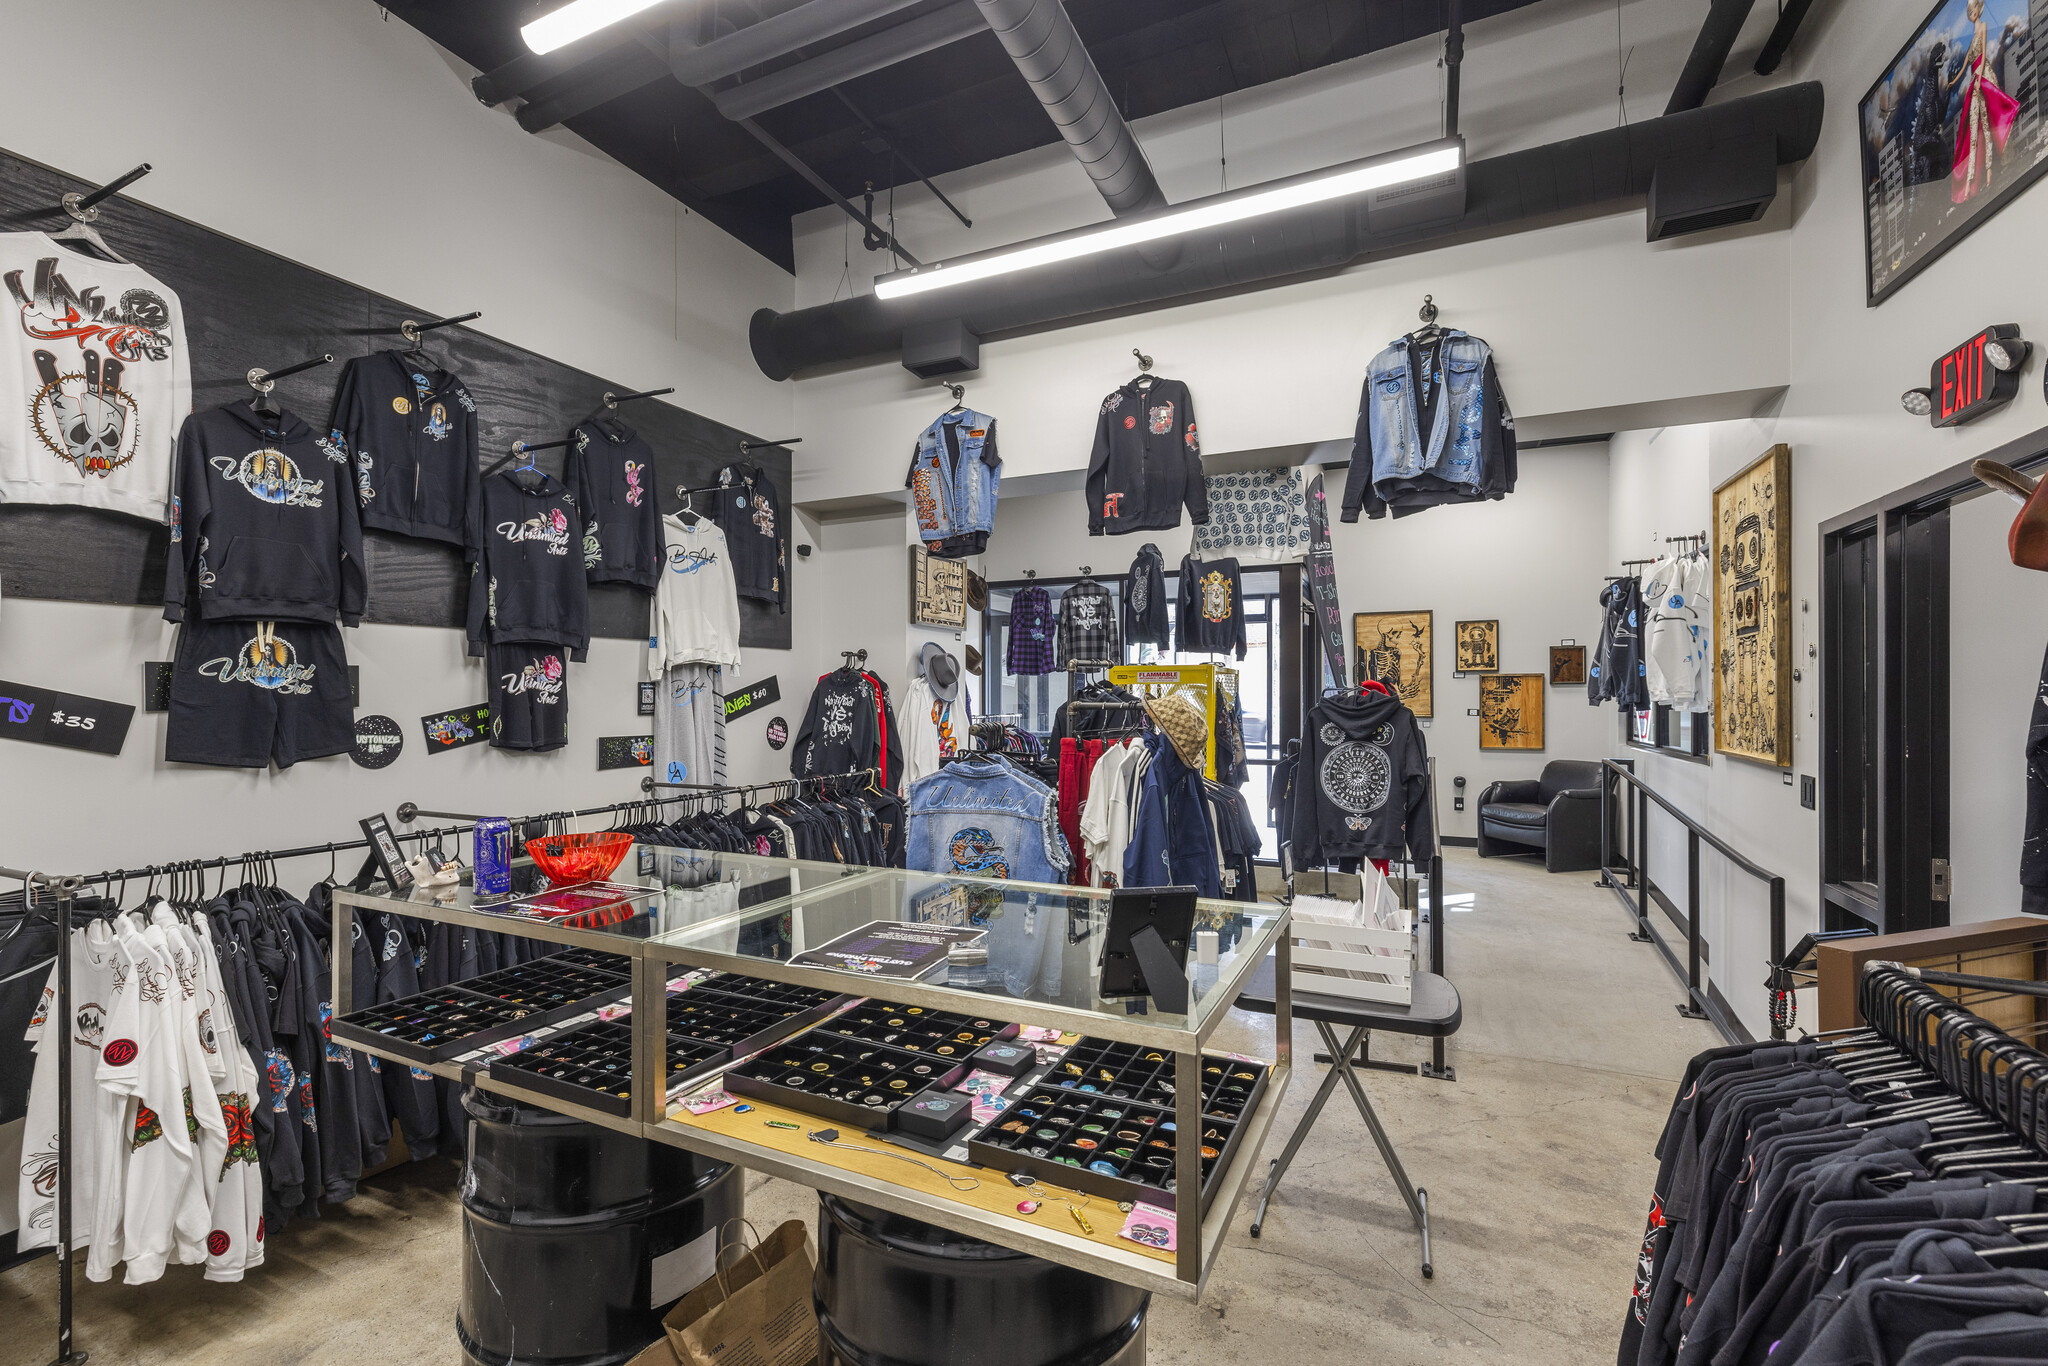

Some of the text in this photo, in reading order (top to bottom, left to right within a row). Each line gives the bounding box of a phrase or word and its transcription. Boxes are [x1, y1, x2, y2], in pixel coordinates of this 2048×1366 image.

[1941, 333, 1987, 419] EXIT
[752, 688, 767, 700] $60
[50, 710, 96, 730] $35
[355, 734, 401, 745] USTOMIZE
[926, 784, 1037, 813] Unlimited
[1142, 1205, 1169, 1216] UNLIMITED
